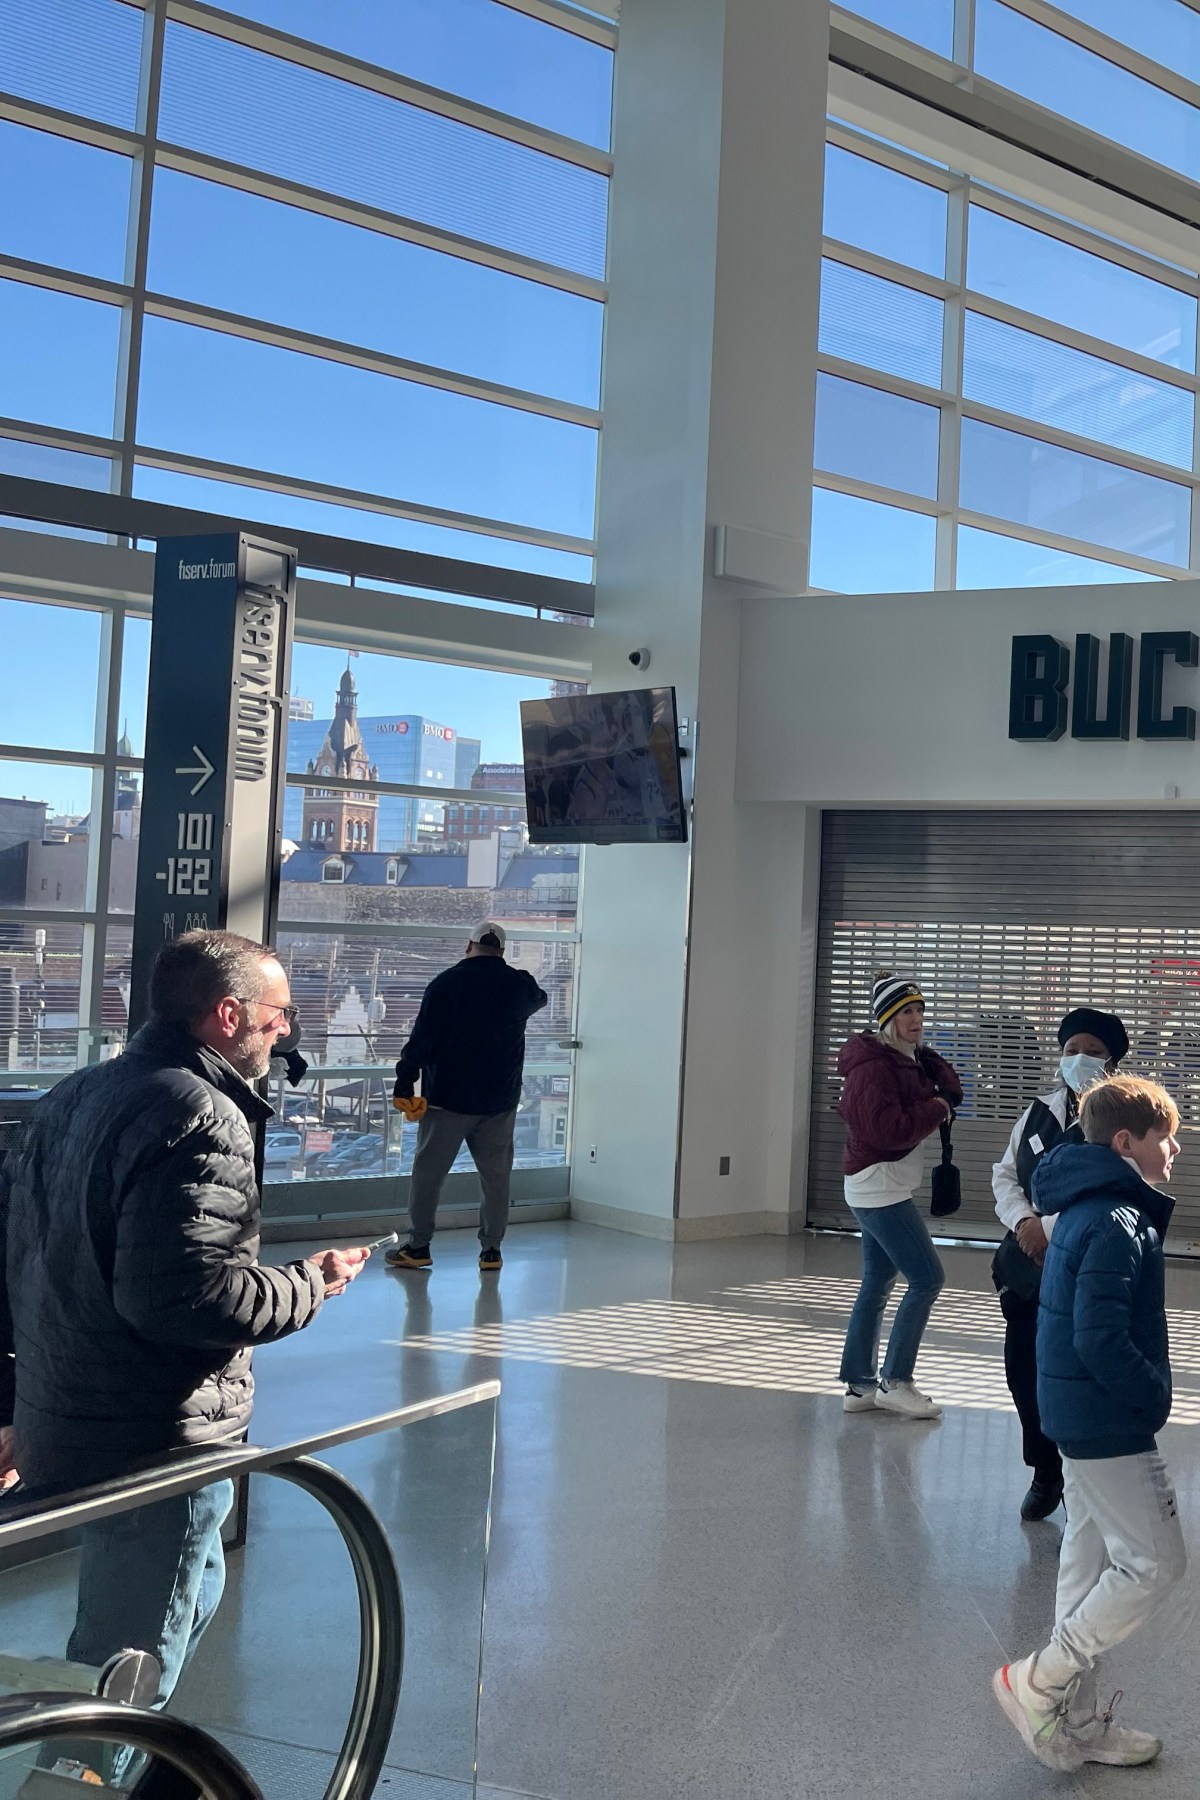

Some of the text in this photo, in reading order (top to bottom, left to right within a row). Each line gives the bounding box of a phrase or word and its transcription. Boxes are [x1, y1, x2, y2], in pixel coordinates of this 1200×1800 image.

[178, 558, 236, 580] fiserv.forum
[233, 583, 284, 783] fiserv.forum
[423, 723, 444, 739] BMO
[178, 813, 213, 850] 101
[156, 858, 211, 895] -122
